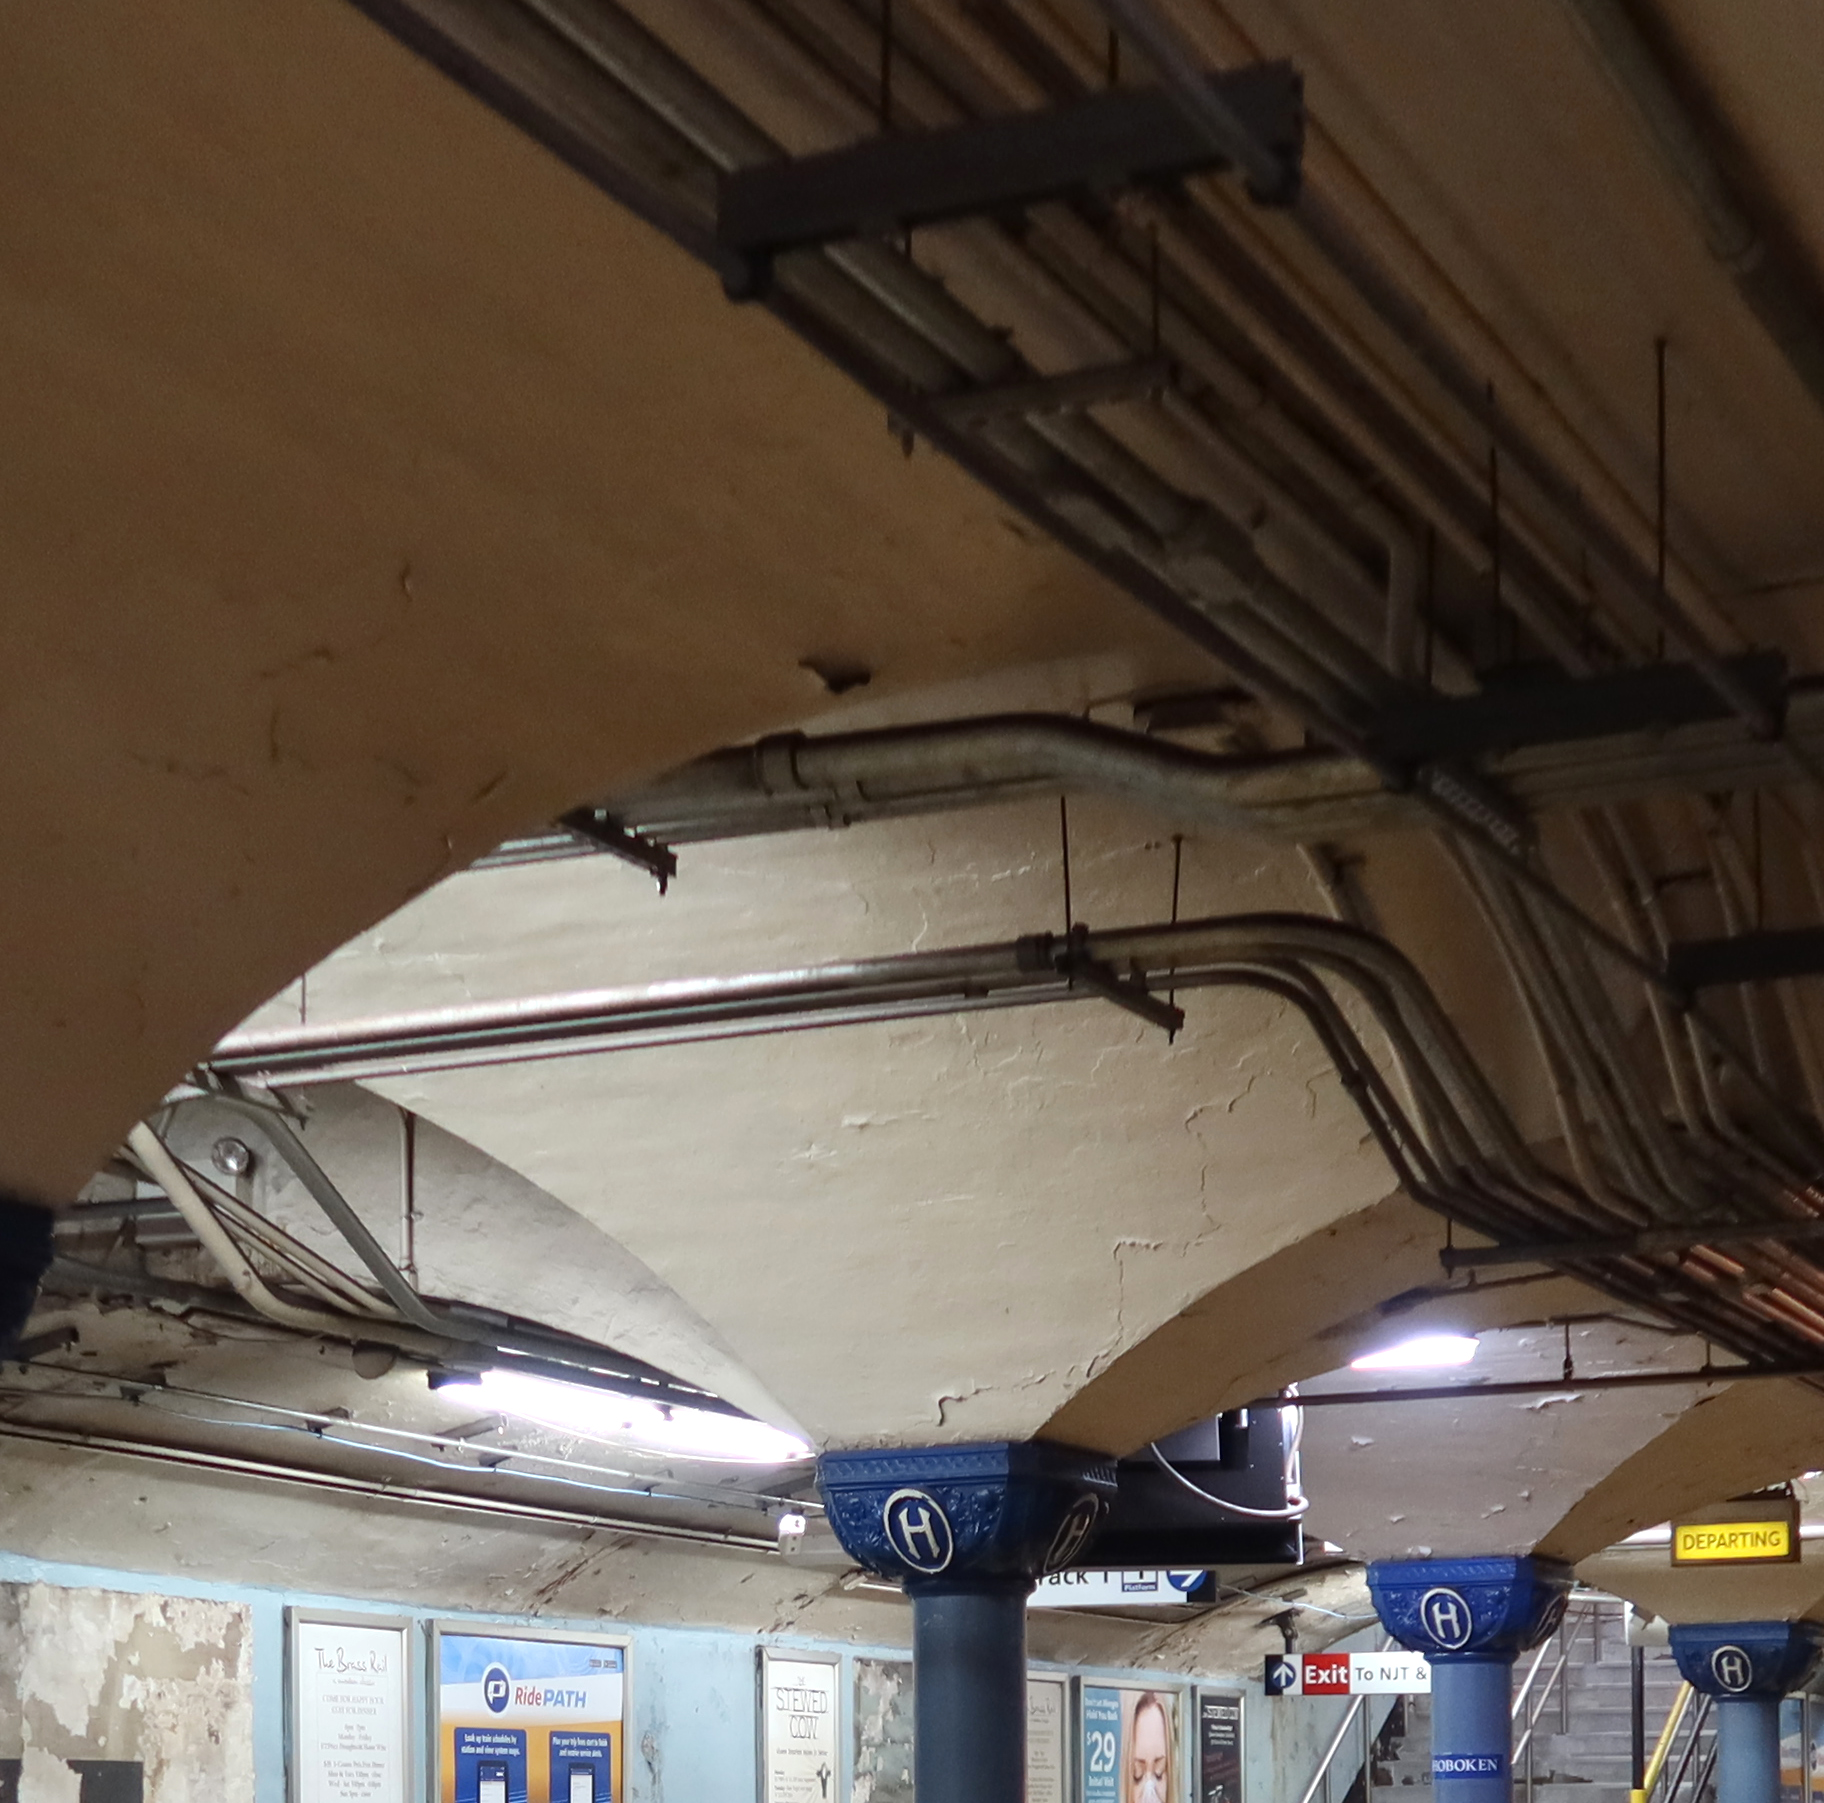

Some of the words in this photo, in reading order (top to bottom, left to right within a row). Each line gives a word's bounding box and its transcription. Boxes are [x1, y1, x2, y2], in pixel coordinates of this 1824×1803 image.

[898, 1506, 941, 1560] H
[1682, 1530, 1781, 1551] DEPARTING
[1039, 1571, 1089, 1586] rack
[1124, 1584, 1156, 1592] Platform
[1432, 1602, 1461, 1639] H
[314, 1647, 335, 1669] The
[336, 1646, 367, 1673] Brass
[1721, 1656, 1744, 1685] H
[1305, 1664, 1348, 1685] Exit
[1355, 1667, 1374, 1681] To
[1380, 1666, 1408, 1681] NJT
[1416, 1666, 1427, 1680] &
[776, 1687, 828, 1714] STEWED
[1087, 1730, 1116, 1773] $29
